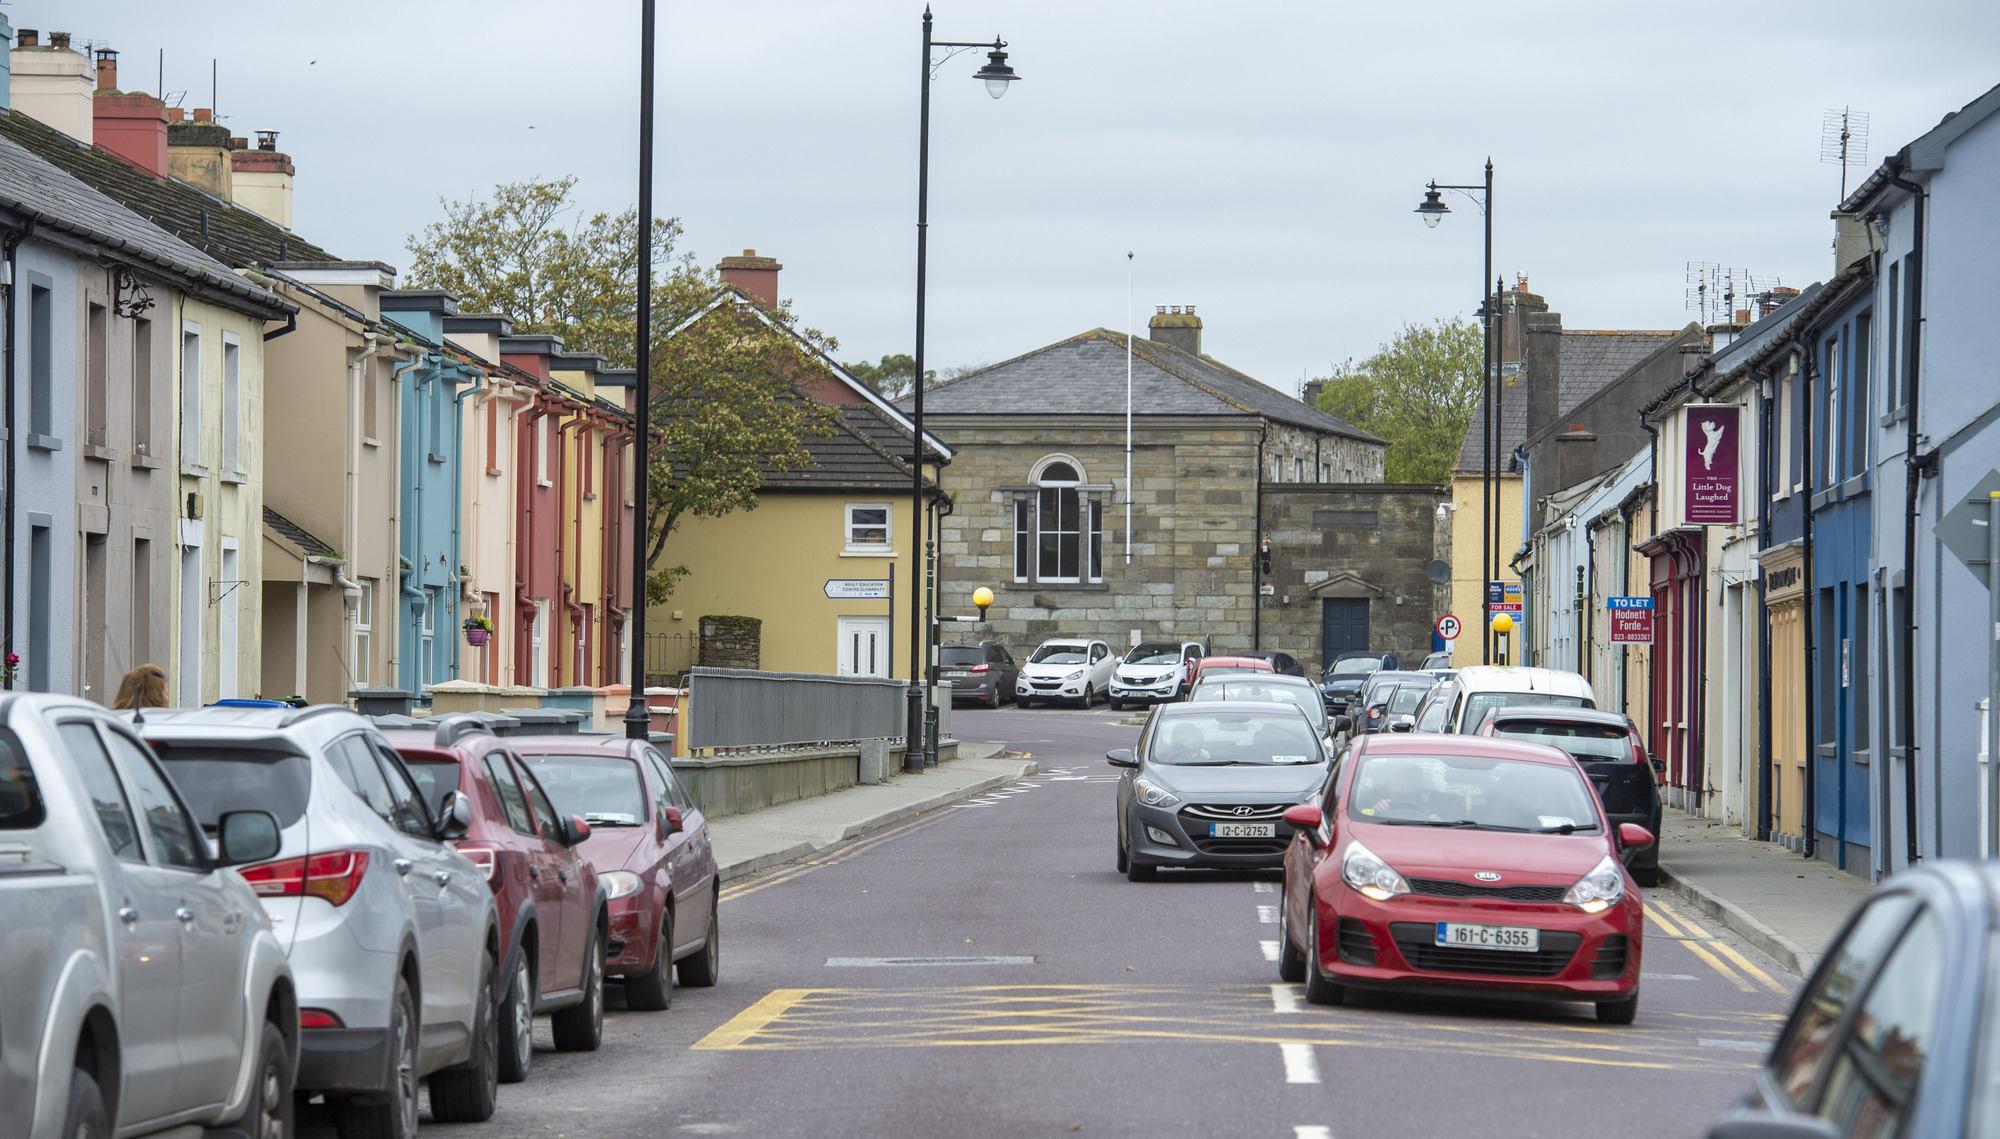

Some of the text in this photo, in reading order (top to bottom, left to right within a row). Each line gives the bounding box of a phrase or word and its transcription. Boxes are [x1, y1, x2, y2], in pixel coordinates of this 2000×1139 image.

[1716, 483, 1732, 492] Dog
[1696, 493, 1728, 502] Laughed
[1614, 598, 1649, 608] TO LET
[1615, 610, 1646, 620] Hodnett
[1620, 620, 1642, 630] Forde
[1222, 826, 1268, 836] 12-C-12752
[1454, 928, 1529, 946] 161-C-6355
